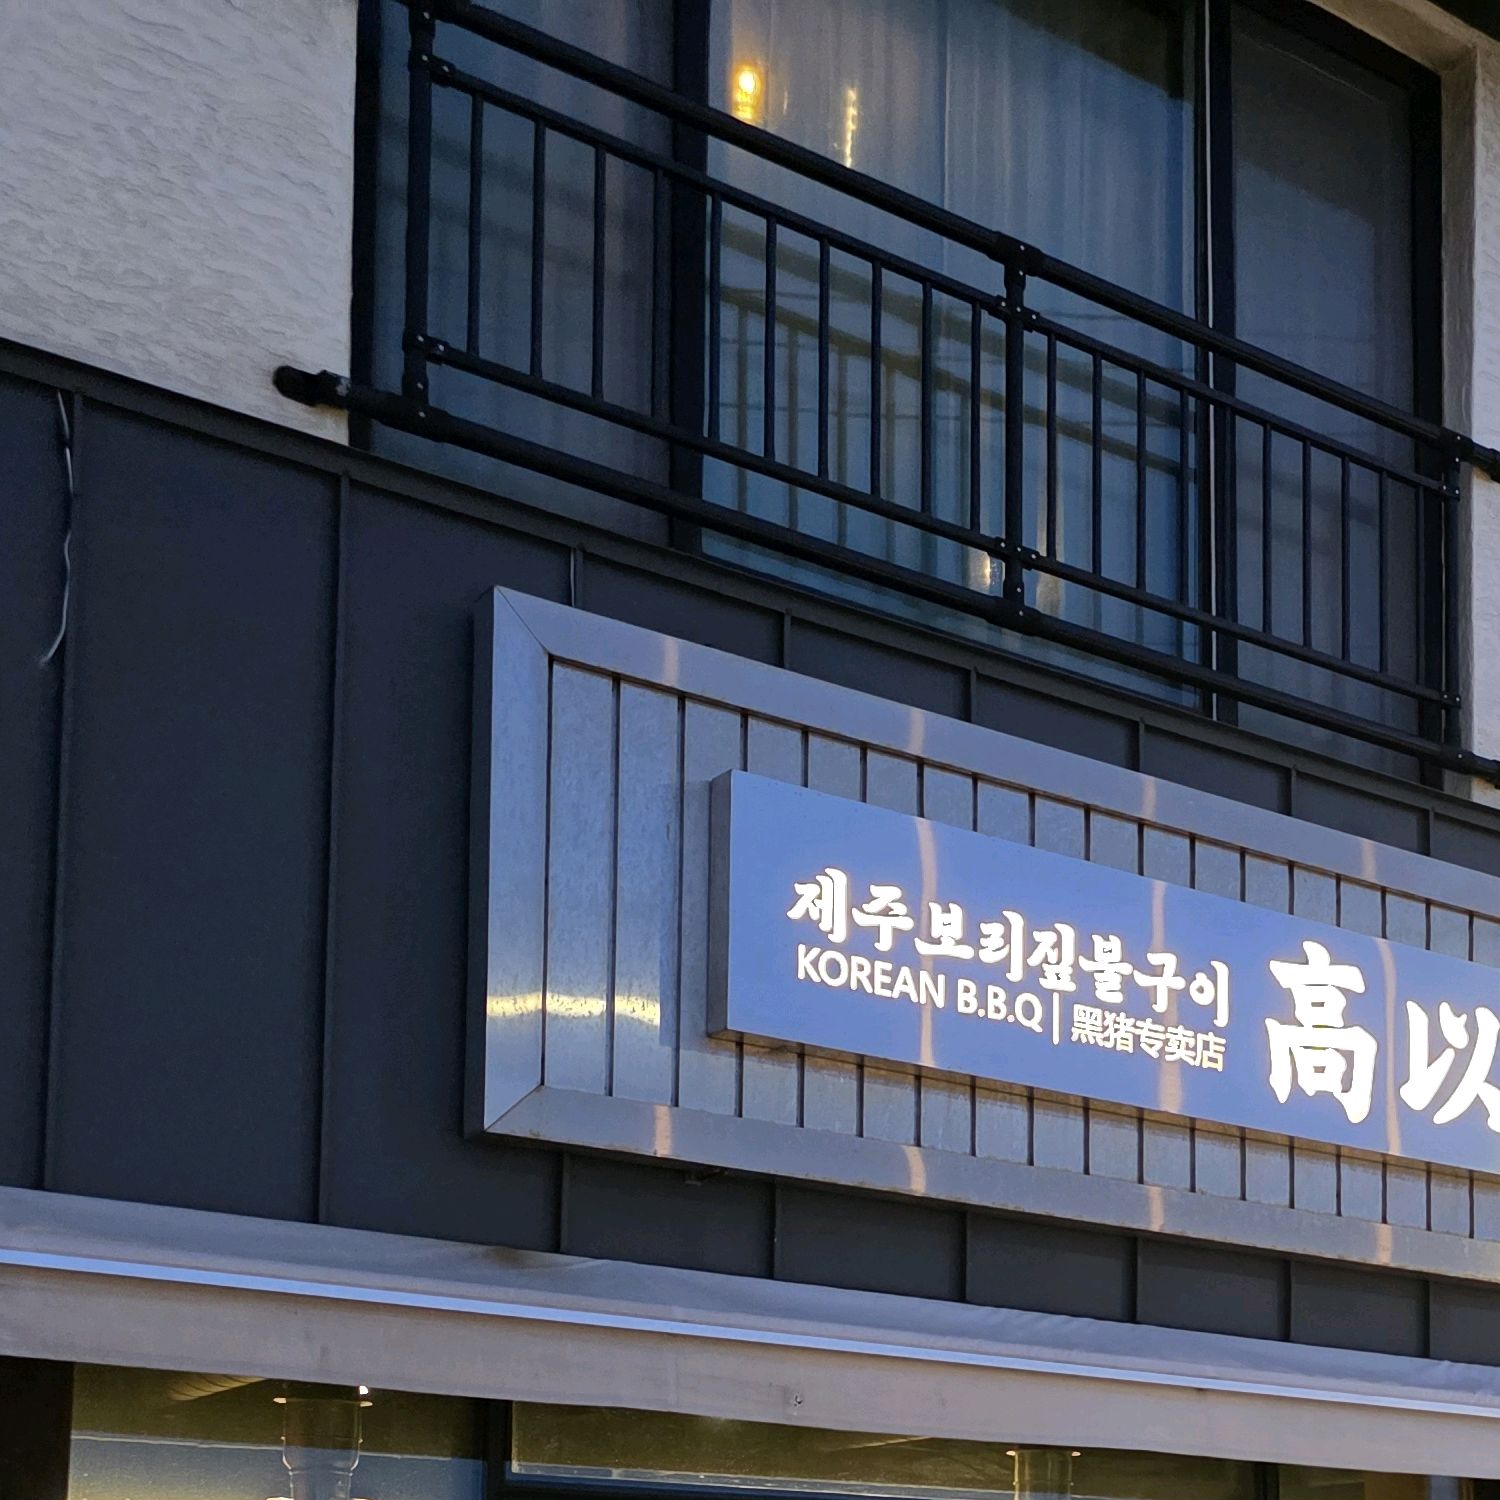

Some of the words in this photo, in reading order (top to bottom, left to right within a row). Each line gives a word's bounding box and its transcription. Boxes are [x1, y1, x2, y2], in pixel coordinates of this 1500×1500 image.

[796, 943, 947, 1009] KOREAN
[956, 978, 1044, 1034] B.B.Q
[1070, 1003, 1228, 1073] 黑猪专卖店
